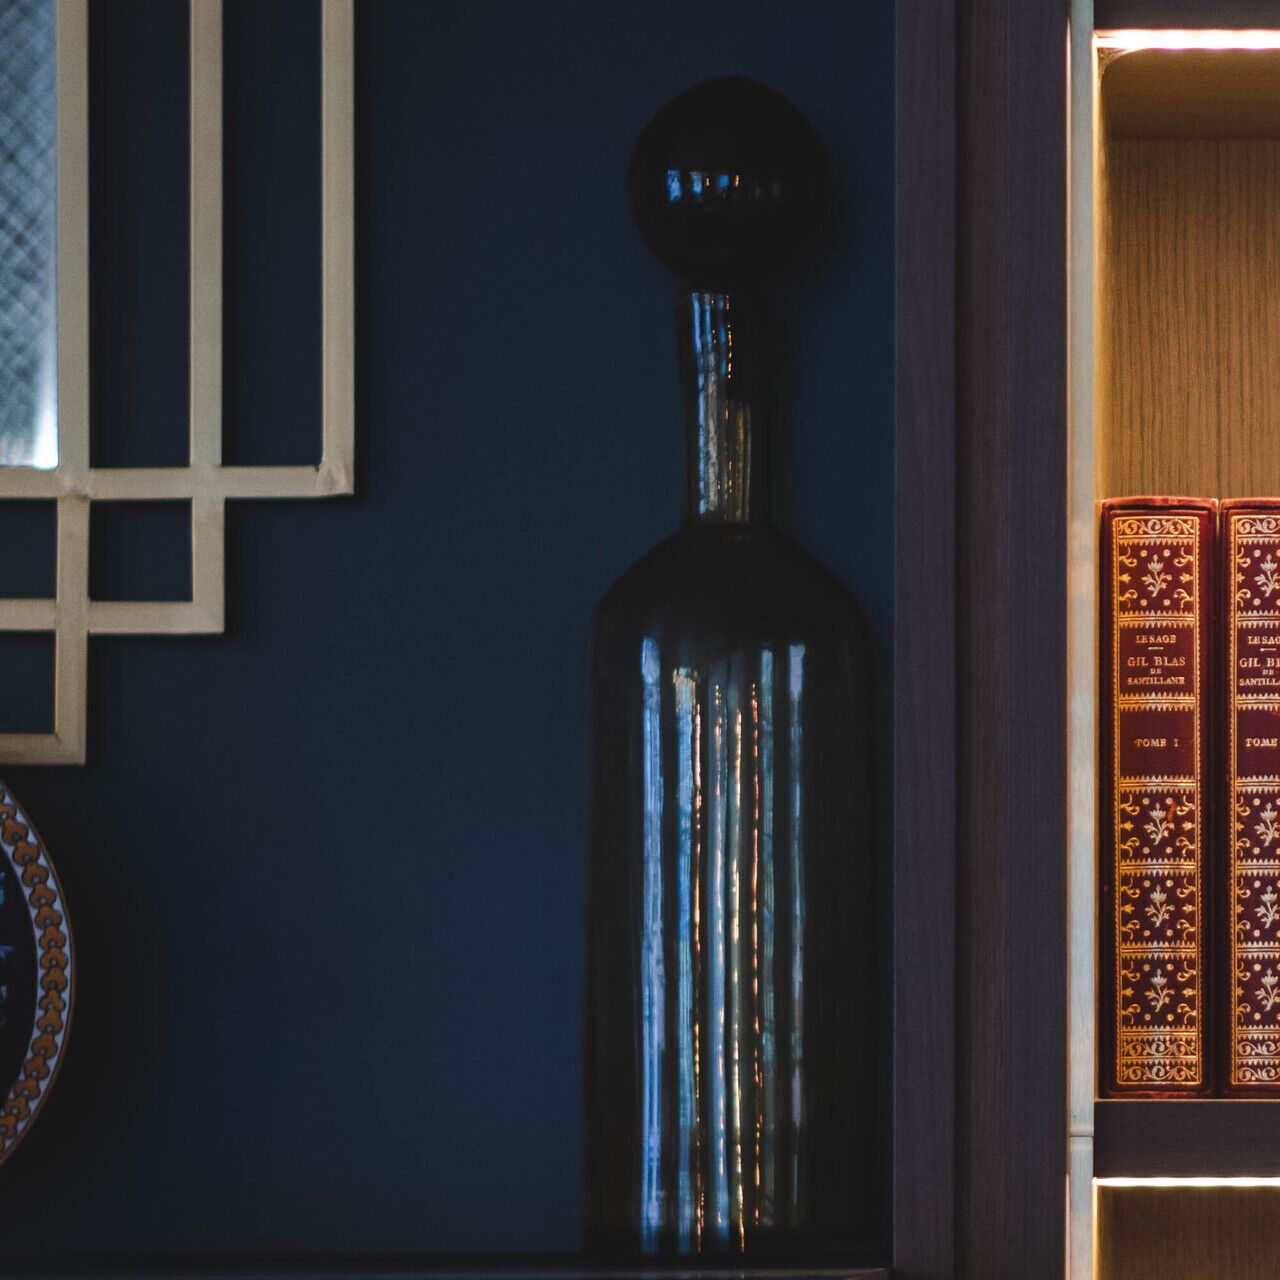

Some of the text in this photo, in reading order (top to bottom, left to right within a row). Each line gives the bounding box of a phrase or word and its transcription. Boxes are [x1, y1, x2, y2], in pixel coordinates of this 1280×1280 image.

[1127, 656, 1186, 666] GIL BLAS
[1239, 657, 1261, 668] GIL
[1127, 676, 1185, 685] SANTILLANE
[1135, 738, 1179, 747] TOME I
[1245, 738, 1278, 747] TOME
